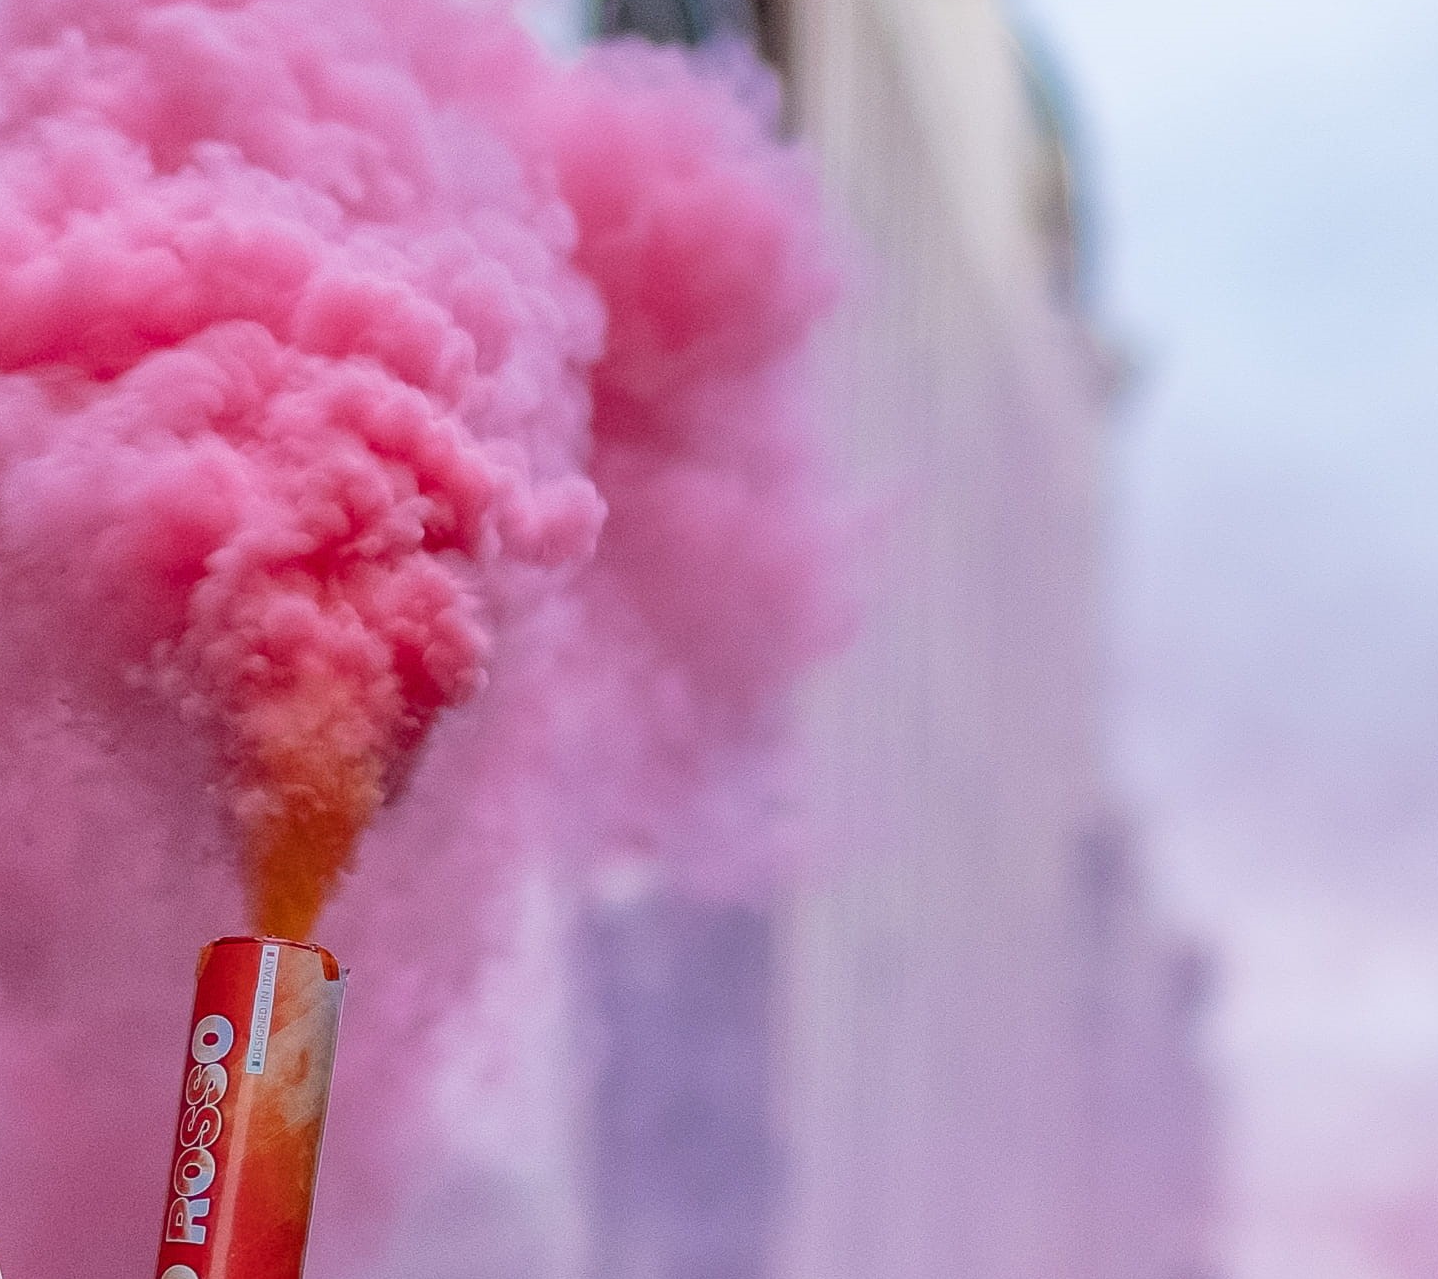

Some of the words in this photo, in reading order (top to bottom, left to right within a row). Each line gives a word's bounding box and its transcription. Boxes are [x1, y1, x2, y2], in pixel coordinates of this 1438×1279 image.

[263, 959, 274, 988] ITALY
[260, 991, 270, 1003] IN
[252, 1009, 267, 1061] DESIGNED
[166, 1014, 234, 1245] ROSSO
